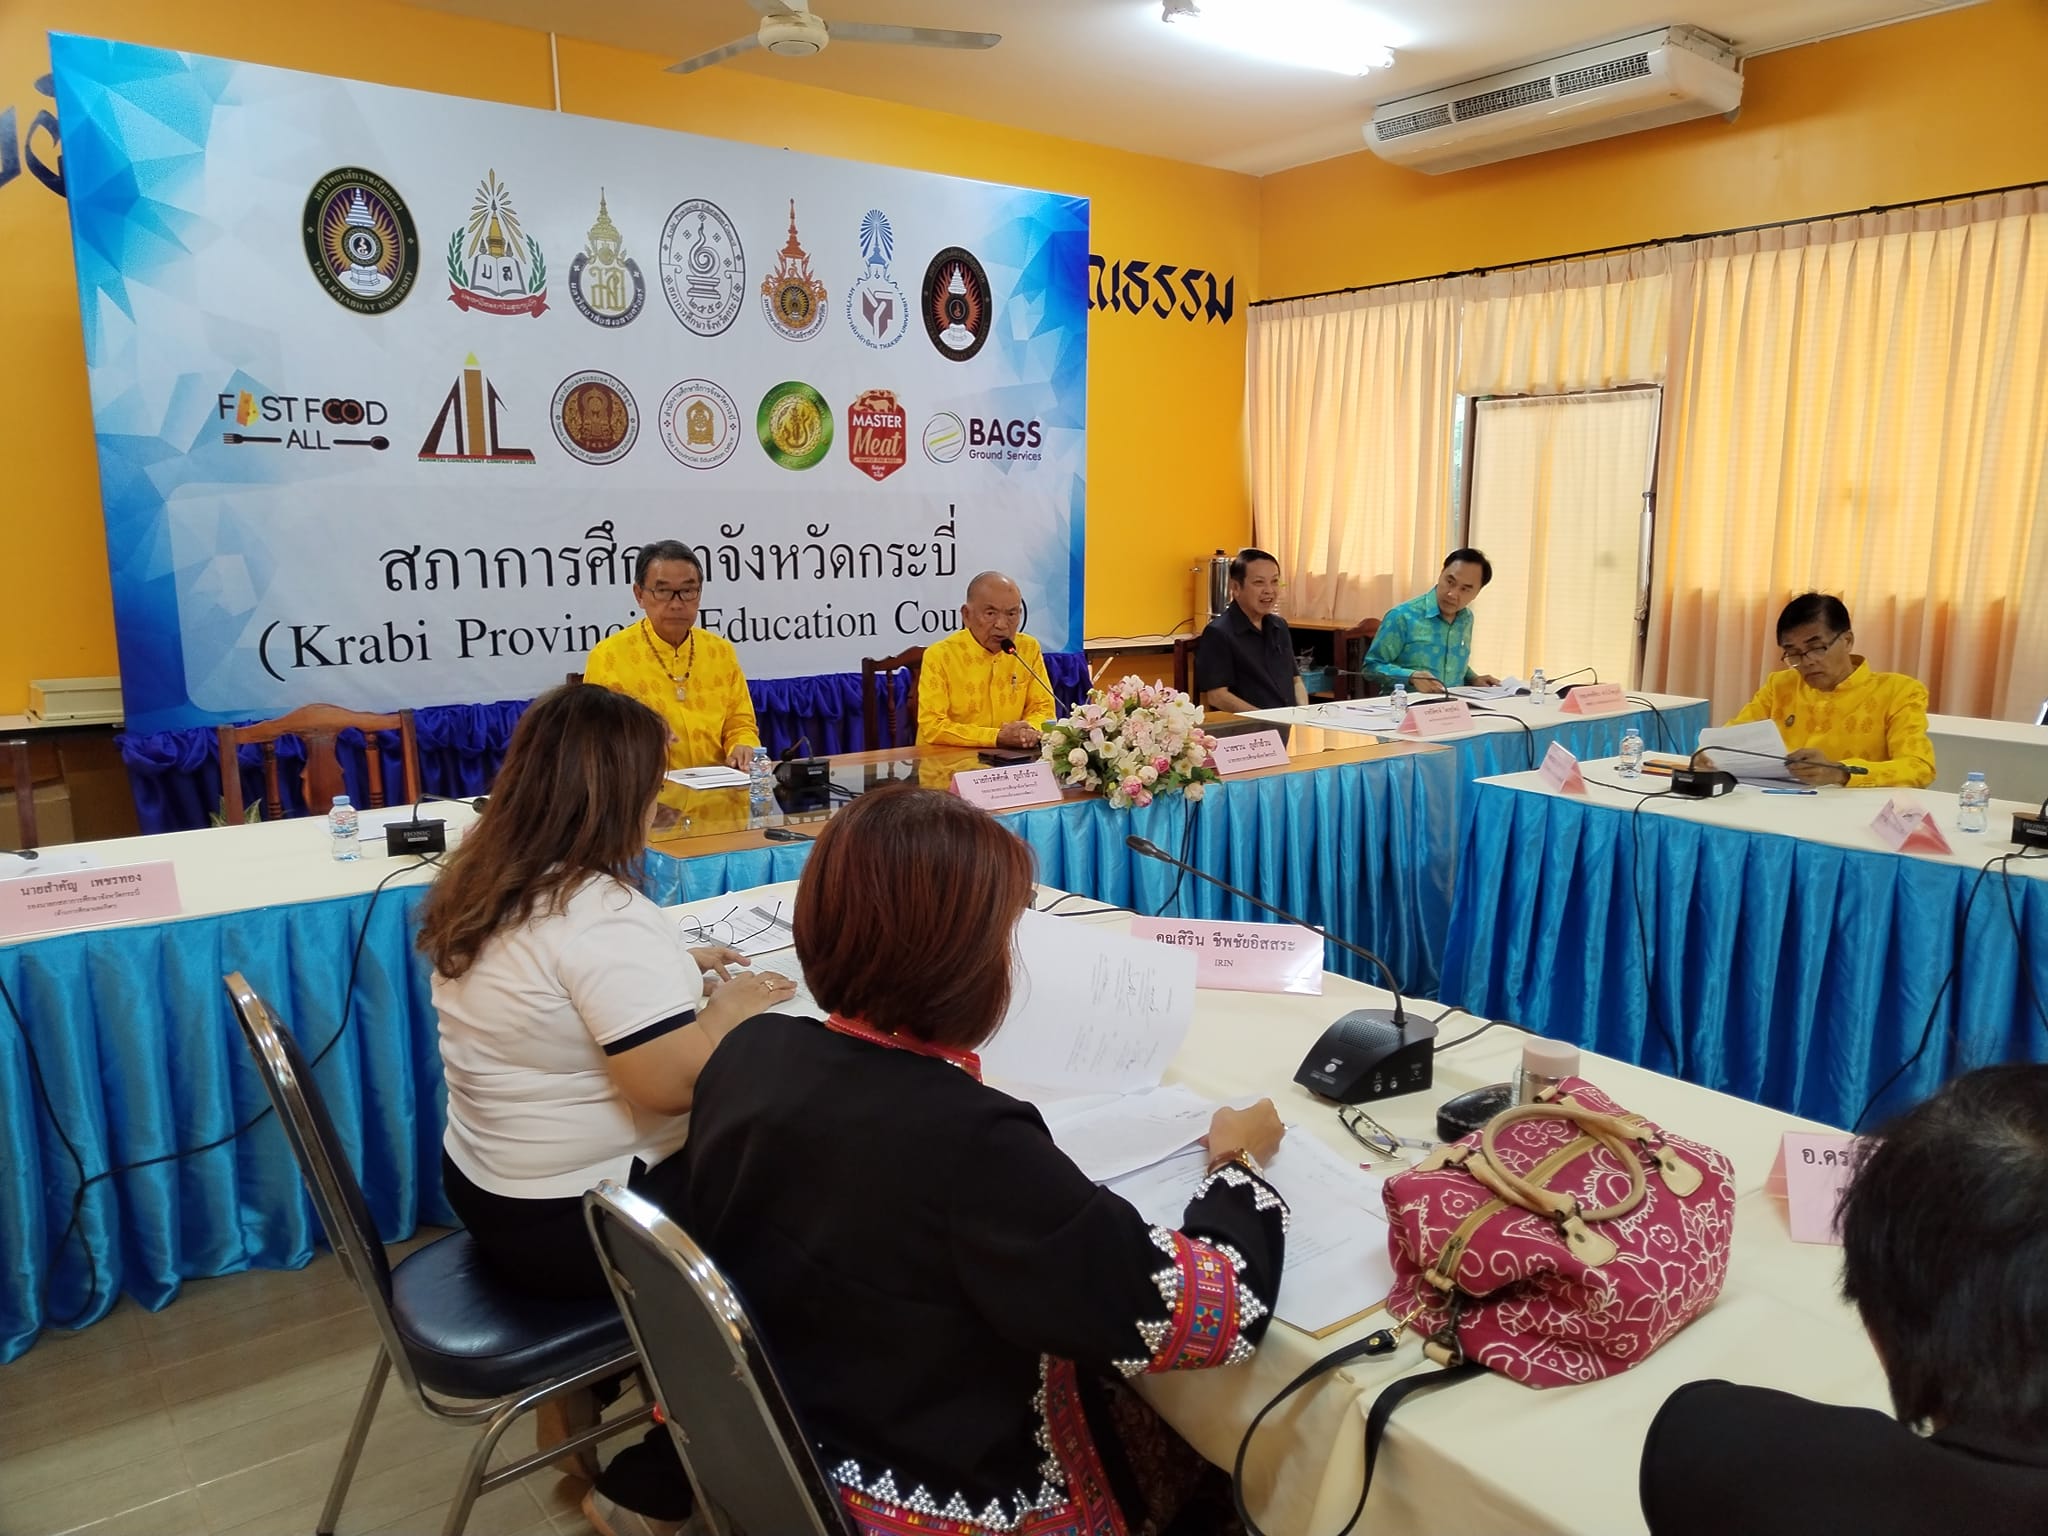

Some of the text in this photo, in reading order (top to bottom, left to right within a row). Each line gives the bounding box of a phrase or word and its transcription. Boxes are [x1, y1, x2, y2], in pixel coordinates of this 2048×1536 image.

[852, 414, 902, 429] MASTER
[969, 418, 1042, 448] BAGS
[286, 429, 331, 450] ALL
[853, 428, 902, 456] Meat
[969, 448, 1042, 462] Ground Services
[379, 504, 957, 592] สภาการศึกาจังหวัดกระบี่
[259, 619, 433, 682] (Krabi
[455, 610, 637, 660] Provin
[698, 603, 878, 644] Education
